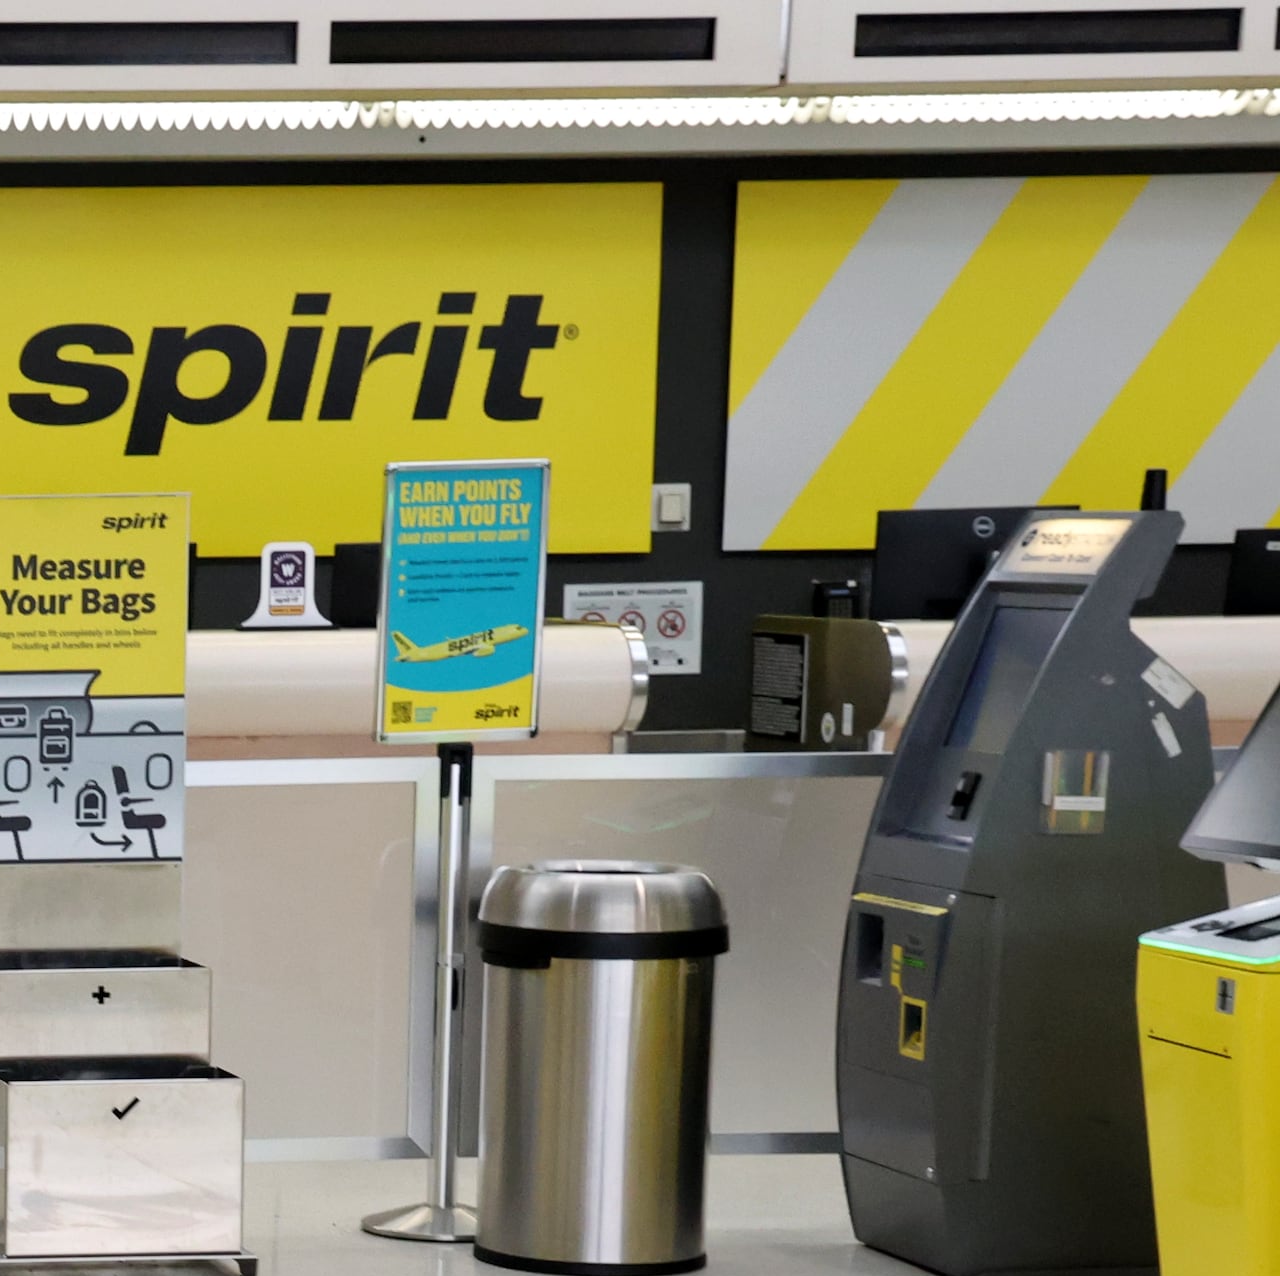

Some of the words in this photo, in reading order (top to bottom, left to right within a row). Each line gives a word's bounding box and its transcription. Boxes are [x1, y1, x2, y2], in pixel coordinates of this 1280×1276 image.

[400, 481, 449, 504] EARN
[453, 478, 522, 502] POINTS
[101, 512, 168, 533] spirit
[400, 504, 455, 528] WHEN
[459, 504, 496, 526] YOU
[500, 502, 532, 525] FLY
[12, 554, 146, 581] Measure
[0, 590, 73, 615] Your
[81, 588, 156, 621] Bags
[448, 628, 494, 653] spirit
[474, 704, 520, 721] spirit
